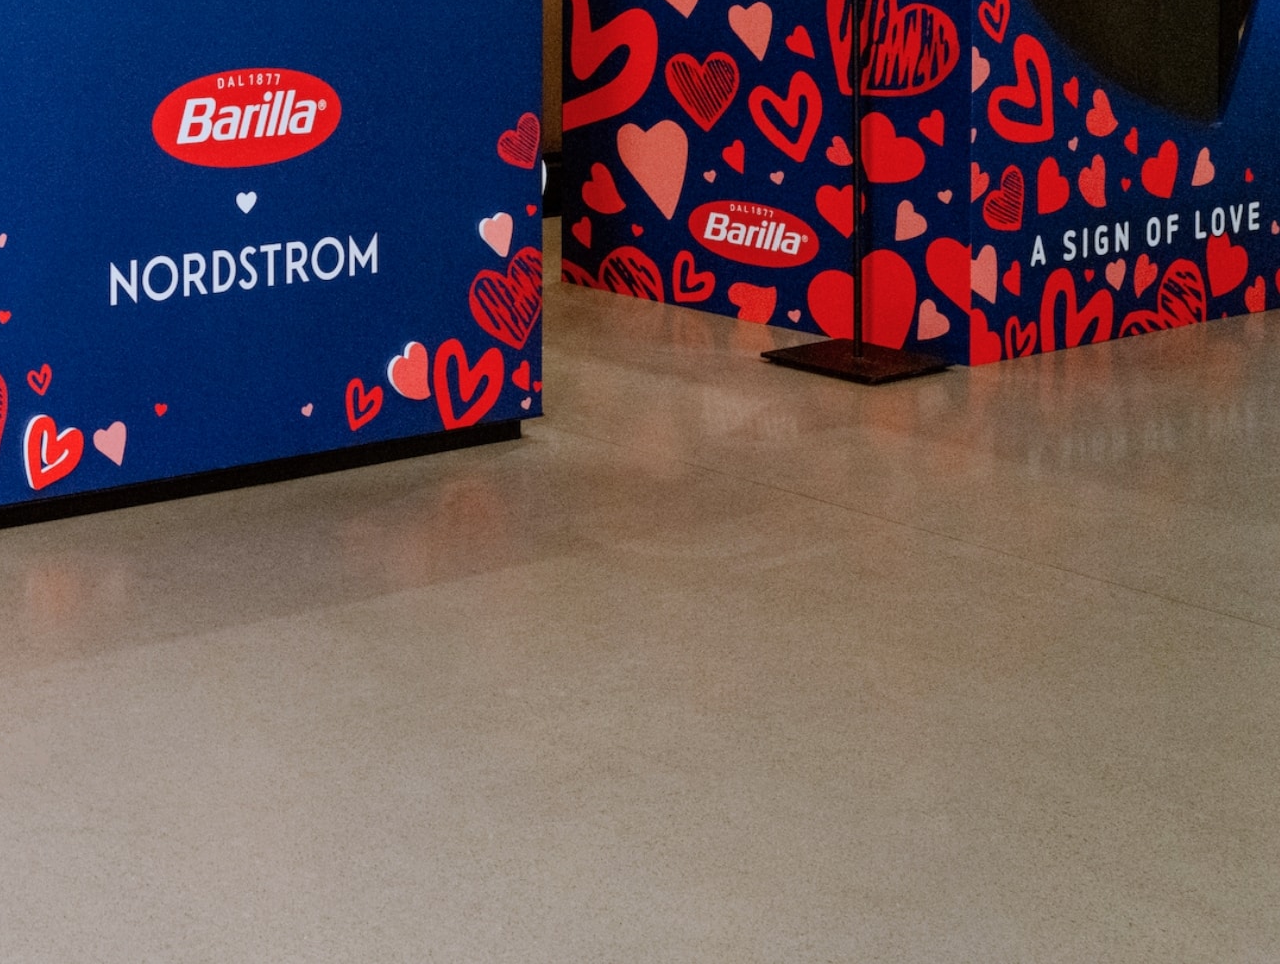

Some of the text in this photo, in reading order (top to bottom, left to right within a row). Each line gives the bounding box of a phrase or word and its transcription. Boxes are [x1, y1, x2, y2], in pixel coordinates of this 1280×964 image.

[217, 73, 281, 89] DAL 1877
[176, 90, 317, 145] Barilla
[703, 212, 801, 256] Barilla
[730, 203, 774, 218] DAL 1877
[1030, 201, 1260, 267] A SIGN OF LOVE
[110, 232, 378, 306] NORDSTROM
